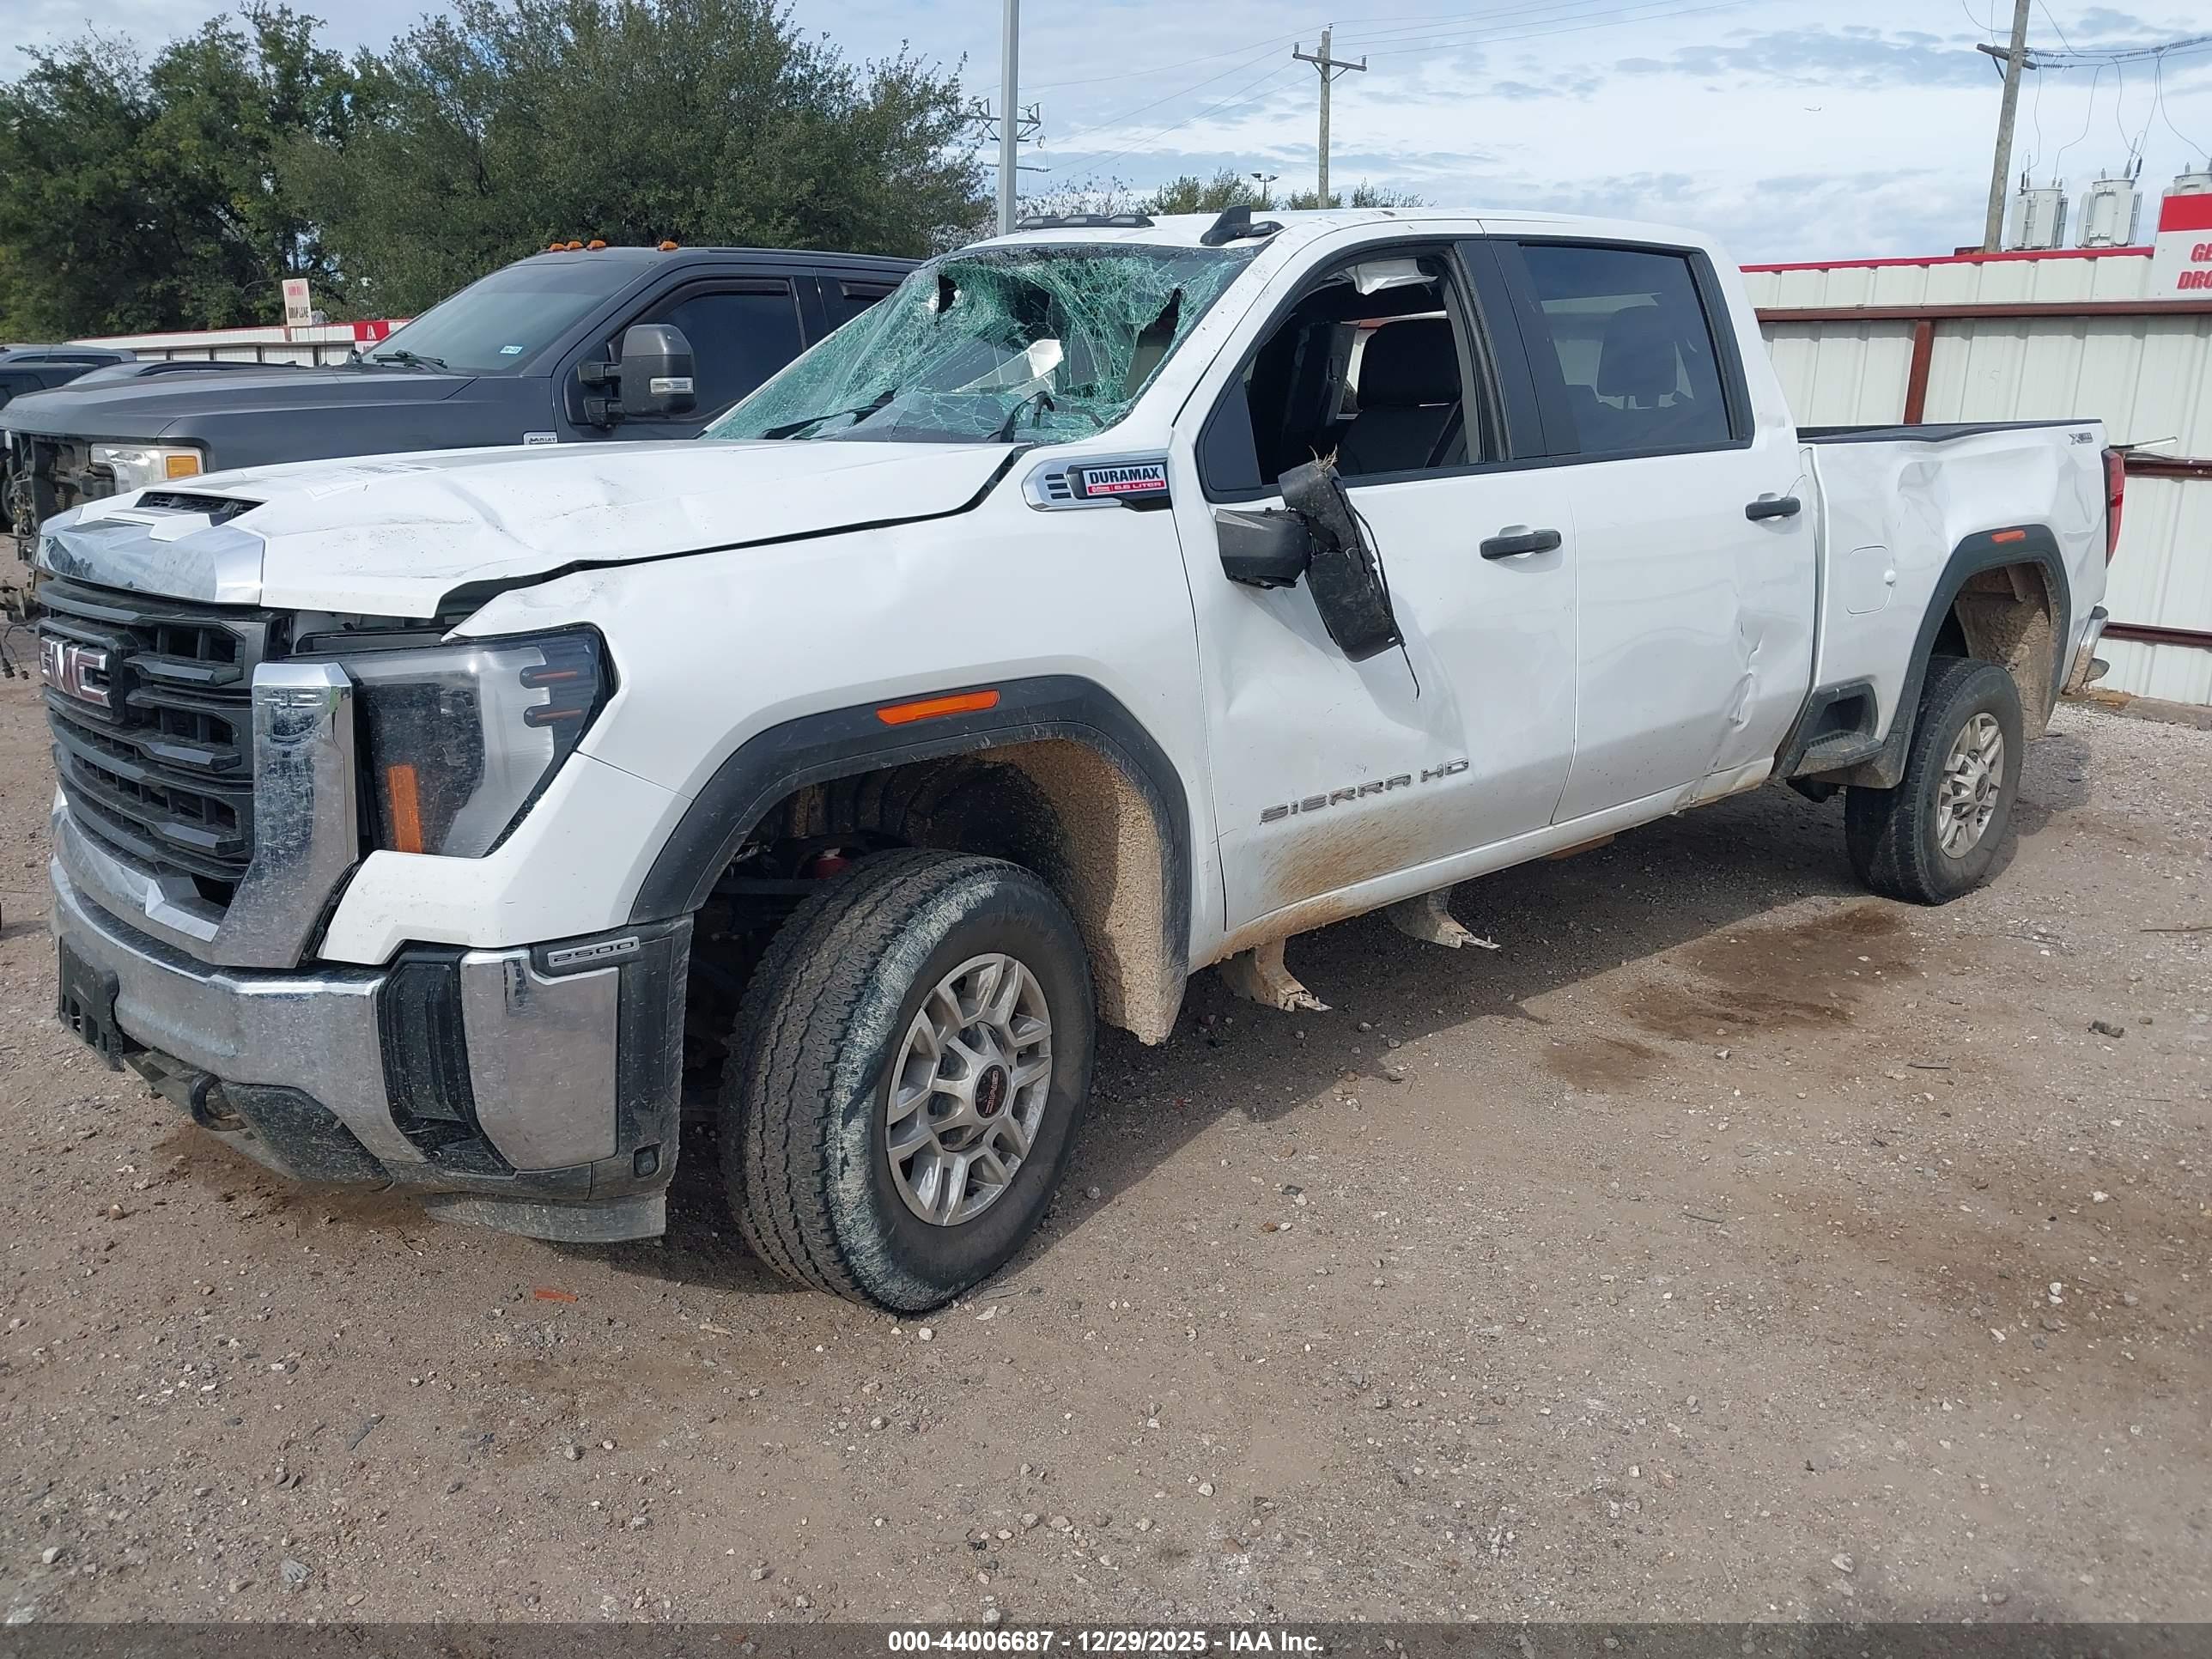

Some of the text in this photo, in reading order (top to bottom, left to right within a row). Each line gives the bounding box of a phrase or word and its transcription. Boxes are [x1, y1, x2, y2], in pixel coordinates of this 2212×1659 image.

[1089, 466, 1161, 485] DURAMAX
[40, 636, 112, 708] GMC
[1260, 757, 1469, 823] SIERRA HD
[553, 941, 635, 963] 2500
[985, 1070, 1000, 1114] GMC
